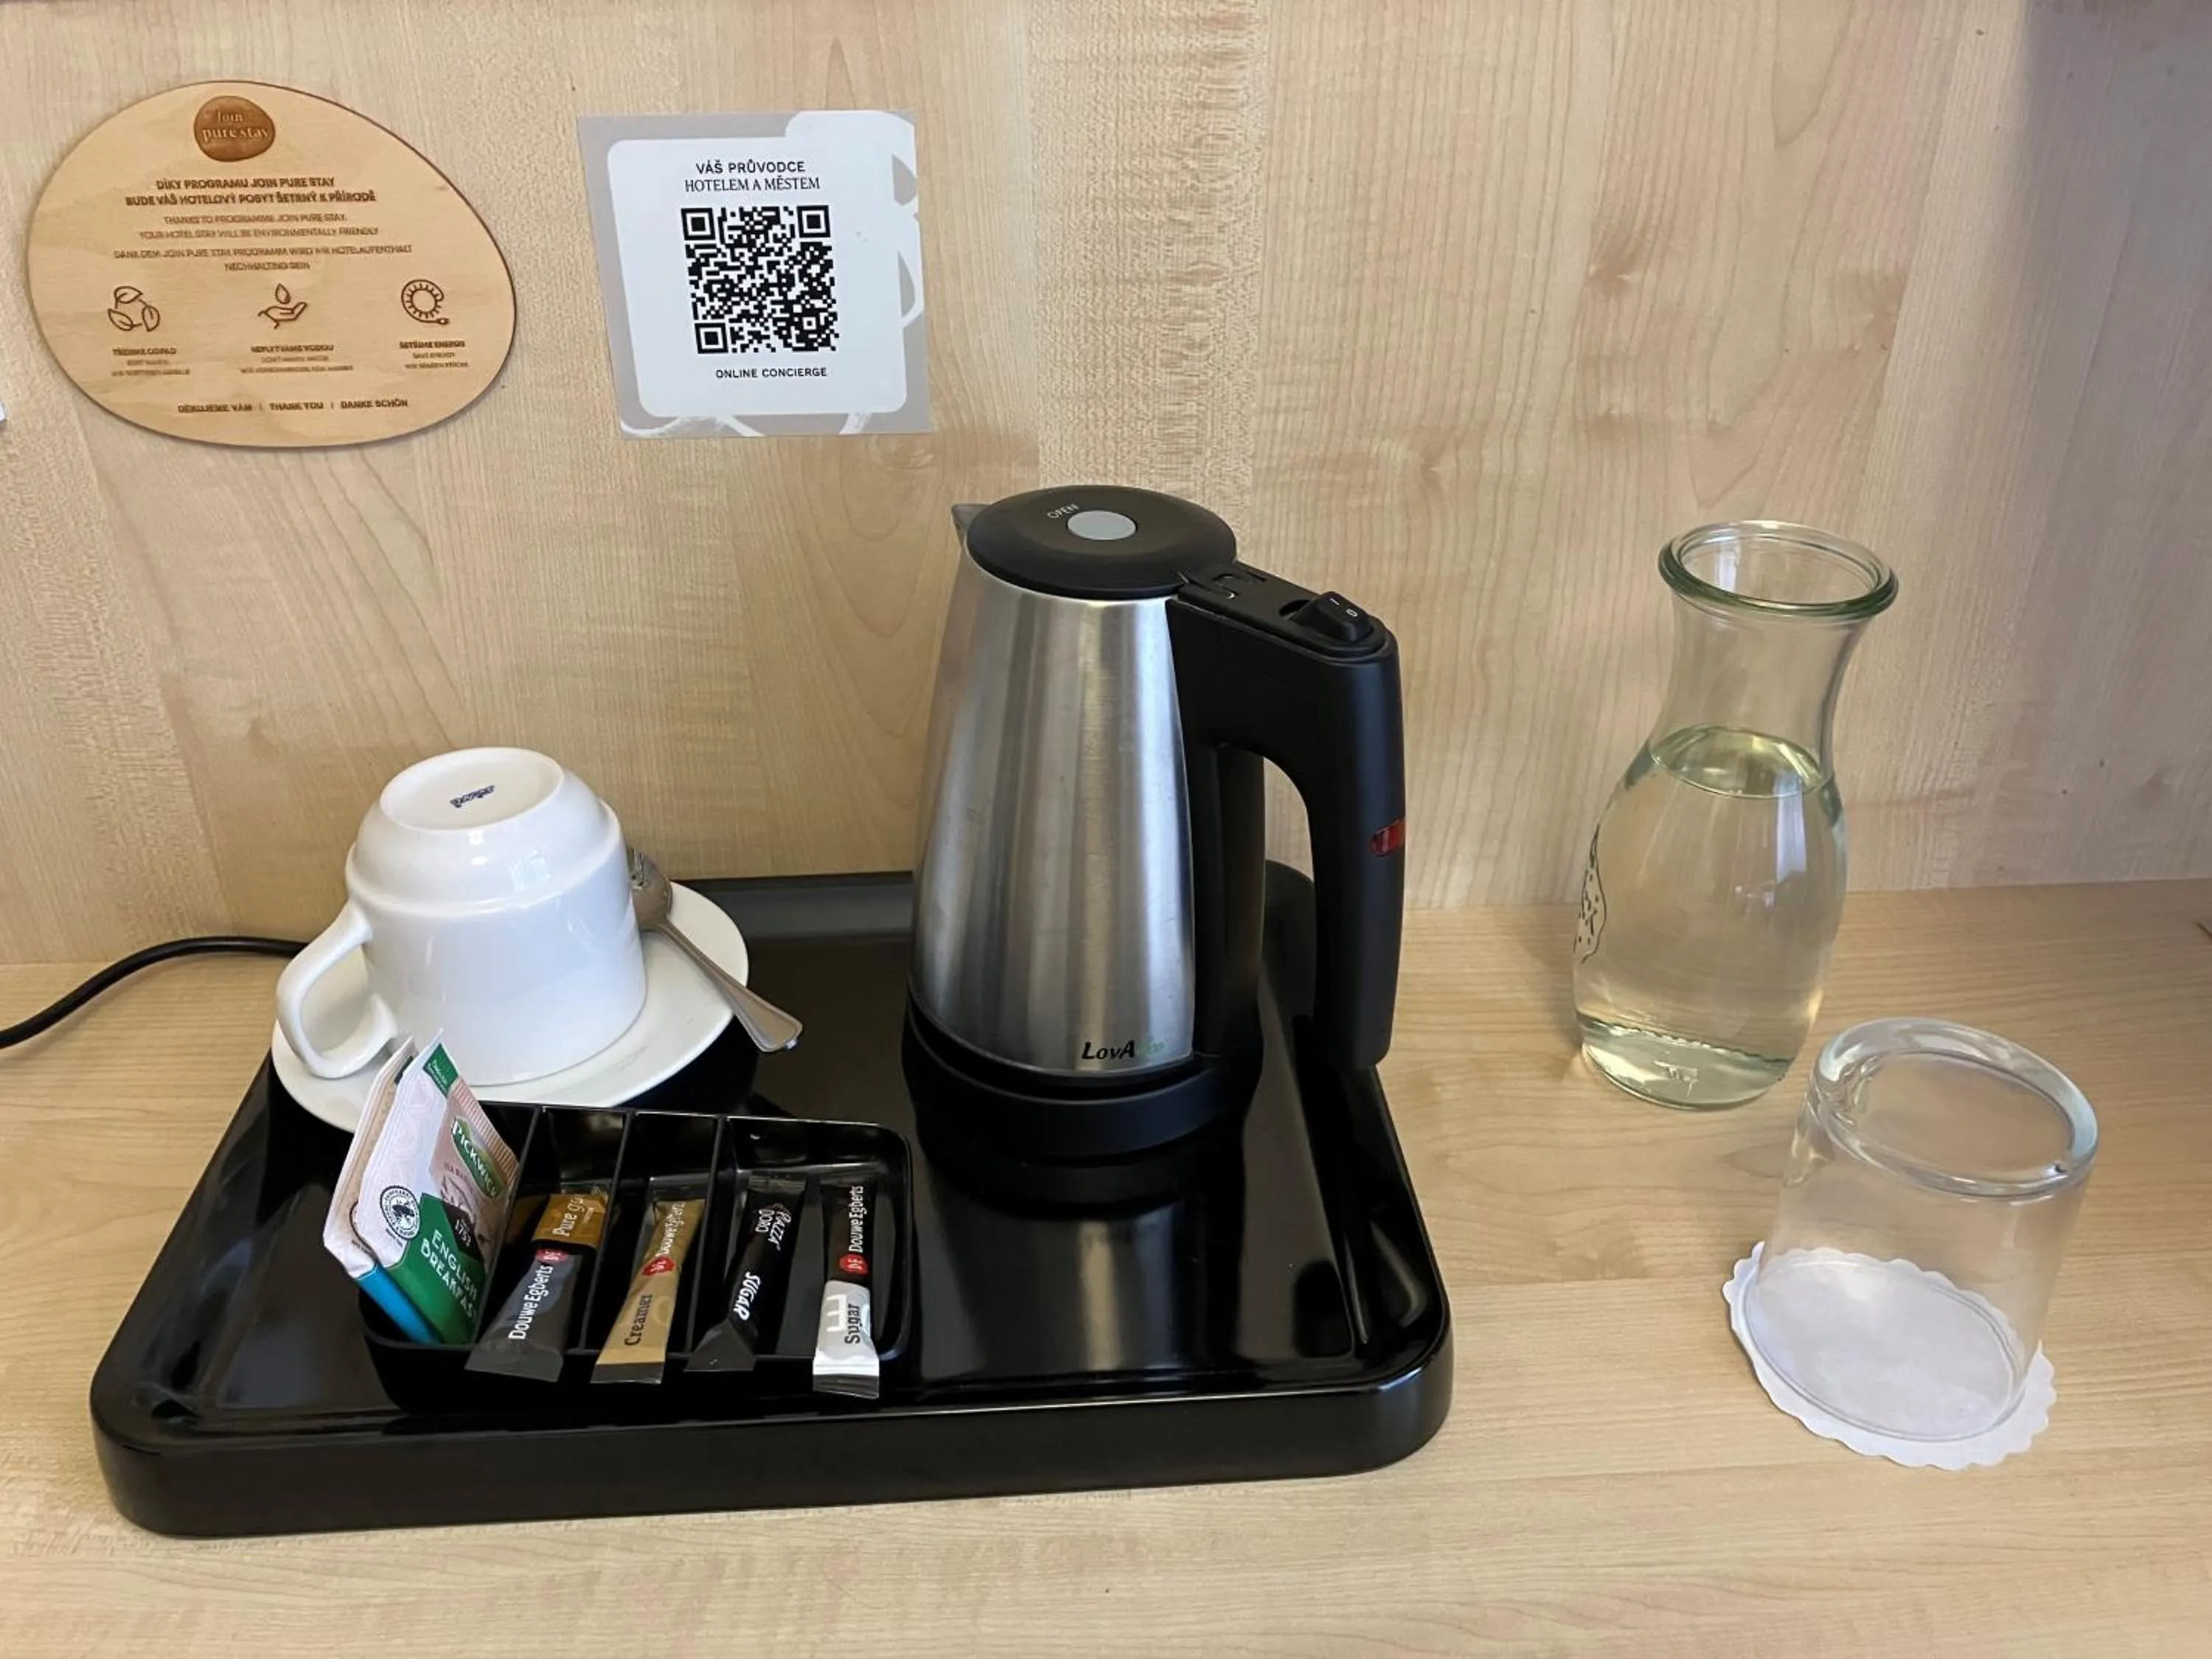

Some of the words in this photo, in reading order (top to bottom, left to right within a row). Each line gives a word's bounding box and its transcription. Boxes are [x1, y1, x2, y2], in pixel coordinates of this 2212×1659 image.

[201, 128, 237, 143] pure
[695, 159, 723, 174] VÁŠ
[728, 159, 806, 173] PRŮVODCE
[184, 178, 248, 189] PROGRAMU
[251, 178, 277, 188] JOIN
[279, 178, 307, 187] PURE
[309, 177, 335, 187] STAY
[685, 178, 749, 192] HOTELEM
[753, 179, 762, 190] A
[765, 175, 821, 190] MĚSTEM
[125, 195, 156, 206] BUDE
[156, 193, 177, 205] VÁŠ
[180, 192, 235, 204] HOTELOVÝ
[239, 194, 274, 204] POBYT
[320, 192, 327, 201] K
[300, 213, 323, 222] PURE
[166, 230, 194, 239] HOTEL
[715, 369, 758, 378] ONLINE
[762, 367, 827, 378] CONCIERGE
[270, 401, 302, 411] THANK
[303, 400, 324, 409] YOU
[341, 400, 373, 409] DANKE
[375, 398, 408, 408] SCHÖN
[452, 1120, 497, 1199] PICKWICK
[849, 1185, 867, 1219] Egberts
[553, 1213, 576, 1237] Pure
[849, 1219, 864, 1253] Douwe
[431, 1228, 478, 1301] ENGLISH
[421, 1238, 475, 1318] BREAKFAS
[508, 1301, 538, 1340] Douwe
[524, 1264, 554, 1303] Egberts
[733, 1270, 761, 1321] SUGAR
[625, 1293, 653, 1346] Creamer
[845, 1303, 863, 1346] Sugar
